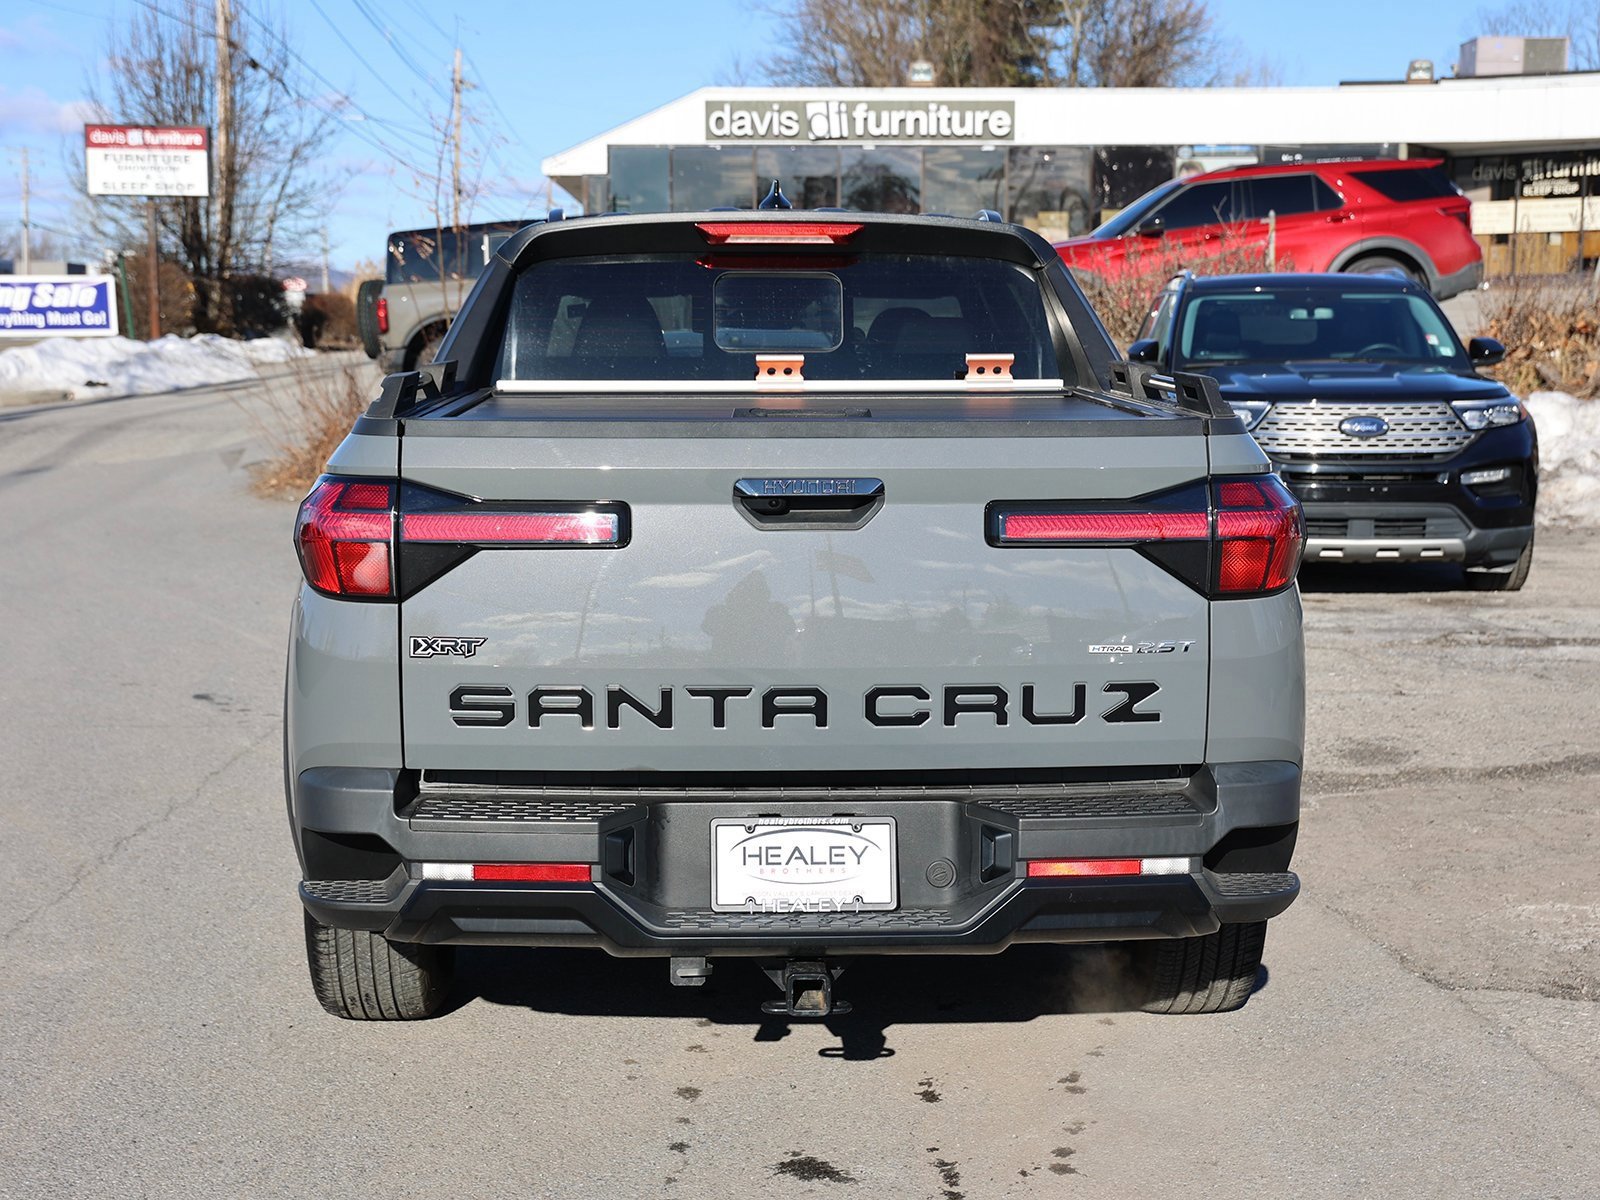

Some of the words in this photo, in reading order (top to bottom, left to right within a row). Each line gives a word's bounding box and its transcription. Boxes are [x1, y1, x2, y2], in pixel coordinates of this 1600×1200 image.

[708, 103, 800, 138] davis
[852, 102, 1012, 138] furniture
[89, 129, 126, 144] davis
[144, 129, 203, 146] furniture
[1472, 162, 1517, 180] davis
[32, 283, 98, 308] Sale
[46, 310, 81, 326] Must
[82, 310, 107, 326] Go!
[763, 479, 856, 494] HYUNDAI
[1090, 644, 1132, 653] HTRAC
[449, 684, 829, 729] SANTA
[863, 680, 1162, 728] CRUZ
[758, 817, 850, 826] healeybrothers.com
[742, 845, 869, 866] HEALEY
[759, 867, 847, 875] BROTHERS
[760, 897, 847, 913] HEALEY
